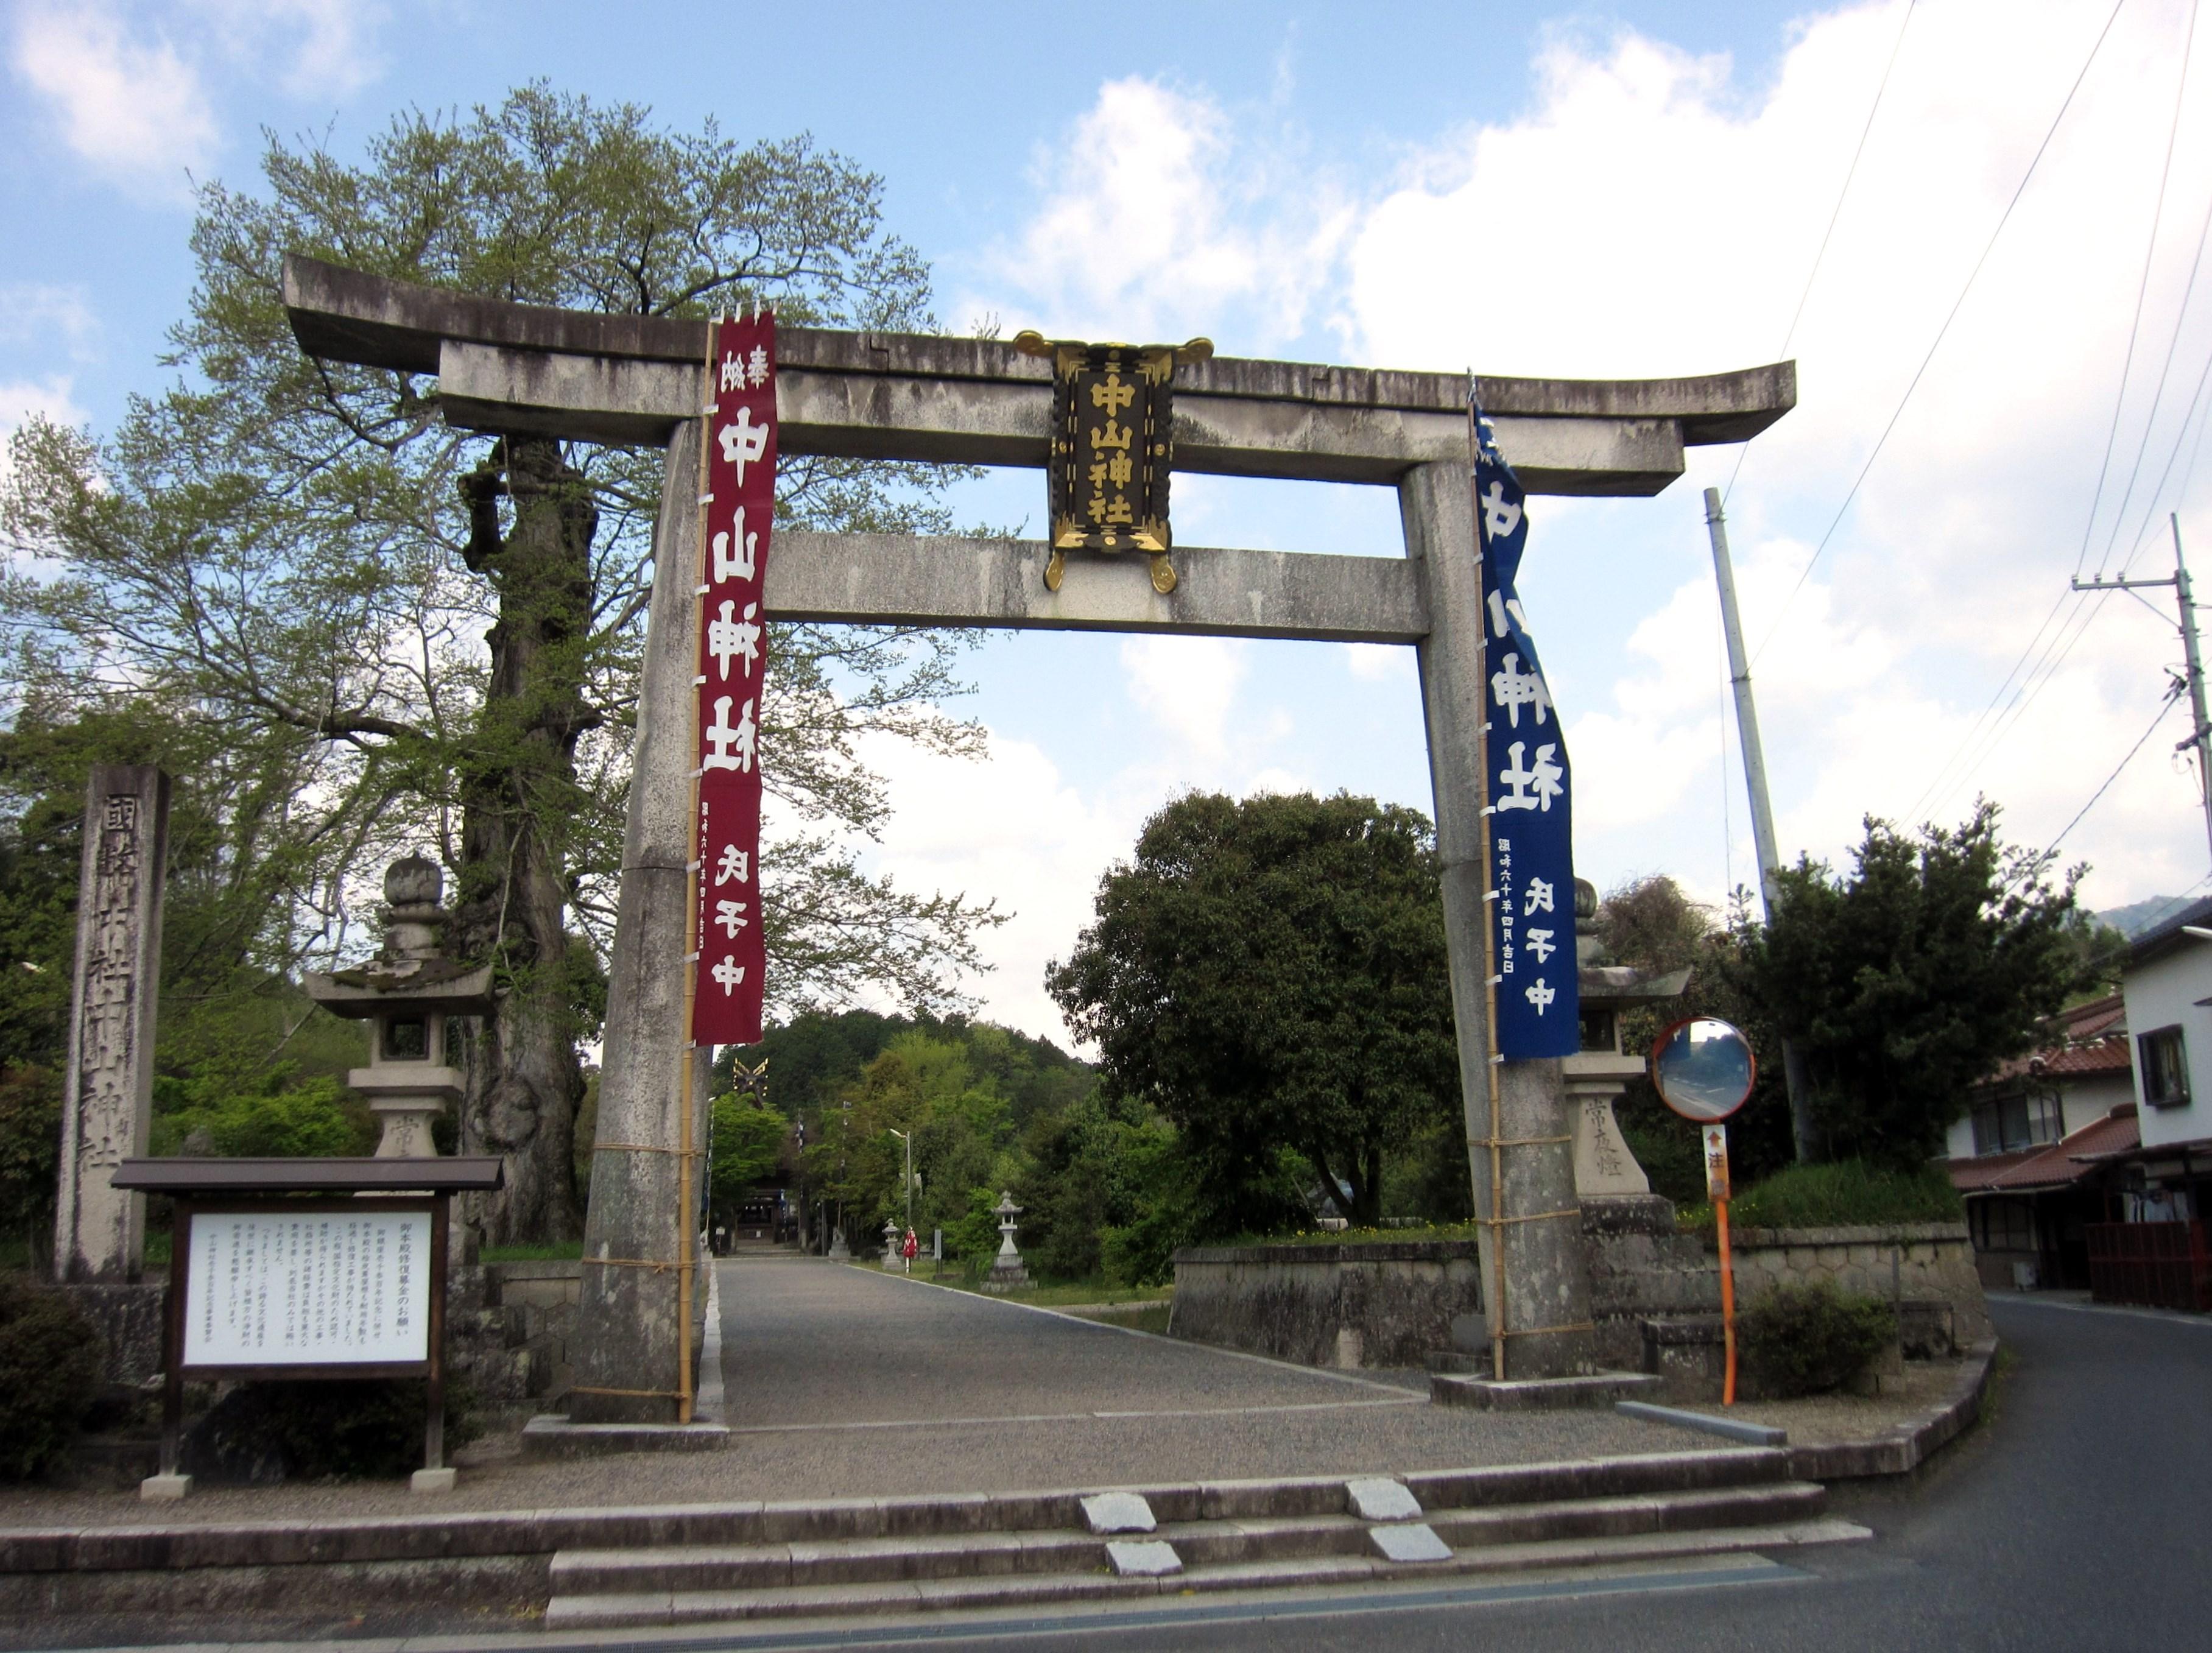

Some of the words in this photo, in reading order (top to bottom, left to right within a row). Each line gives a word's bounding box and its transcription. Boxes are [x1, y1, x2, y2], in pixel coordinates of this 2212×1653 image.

[1087, 373, 1135, 524] 中山神社
[1585, 1097, 1622, 1175] 常夜燈
[396, 1223, 412, 1336] 御本殿修復募金のお願い
